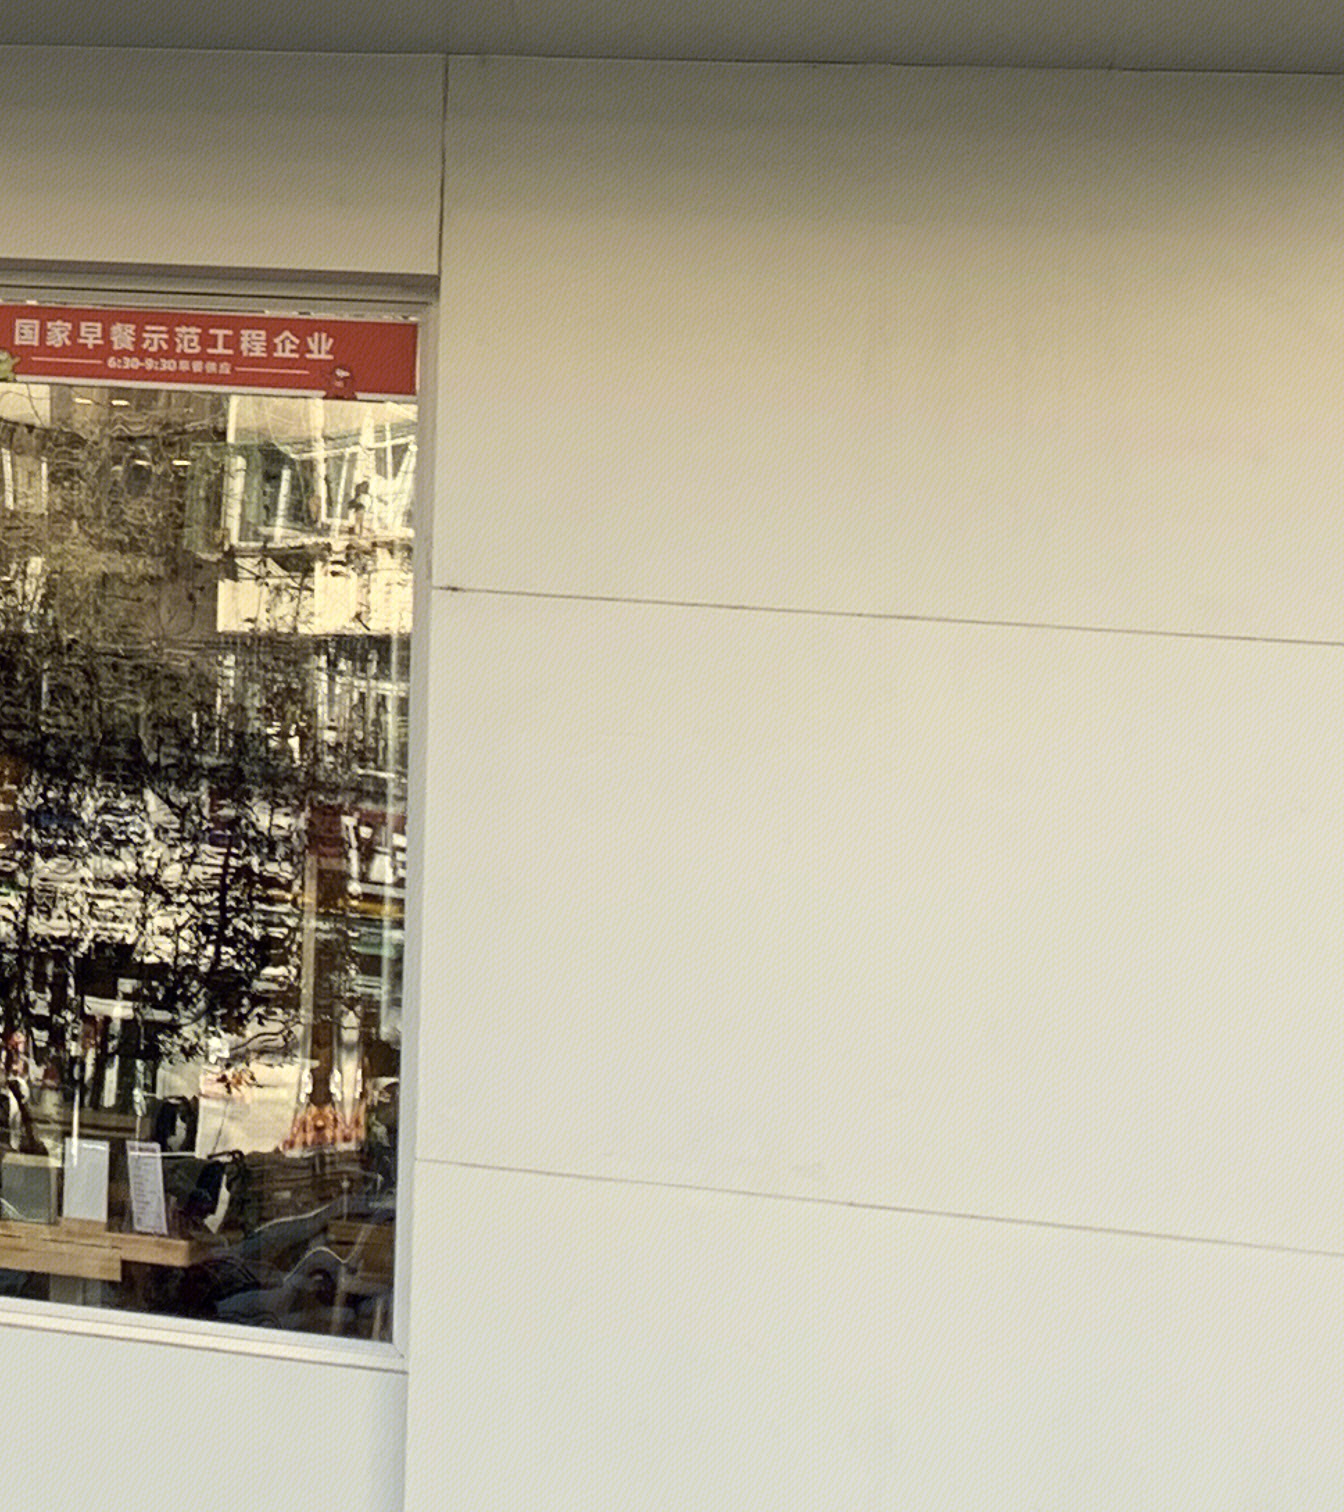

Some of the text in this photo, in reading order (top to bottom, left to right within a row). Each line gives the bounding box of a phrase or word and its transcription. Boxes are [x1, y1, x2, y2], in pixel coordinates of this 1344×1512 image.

[14, 317, 335, 362] 国家早餐示范工程企业
[107, 356, 232, 375] 6:30-9:30早餐供应
